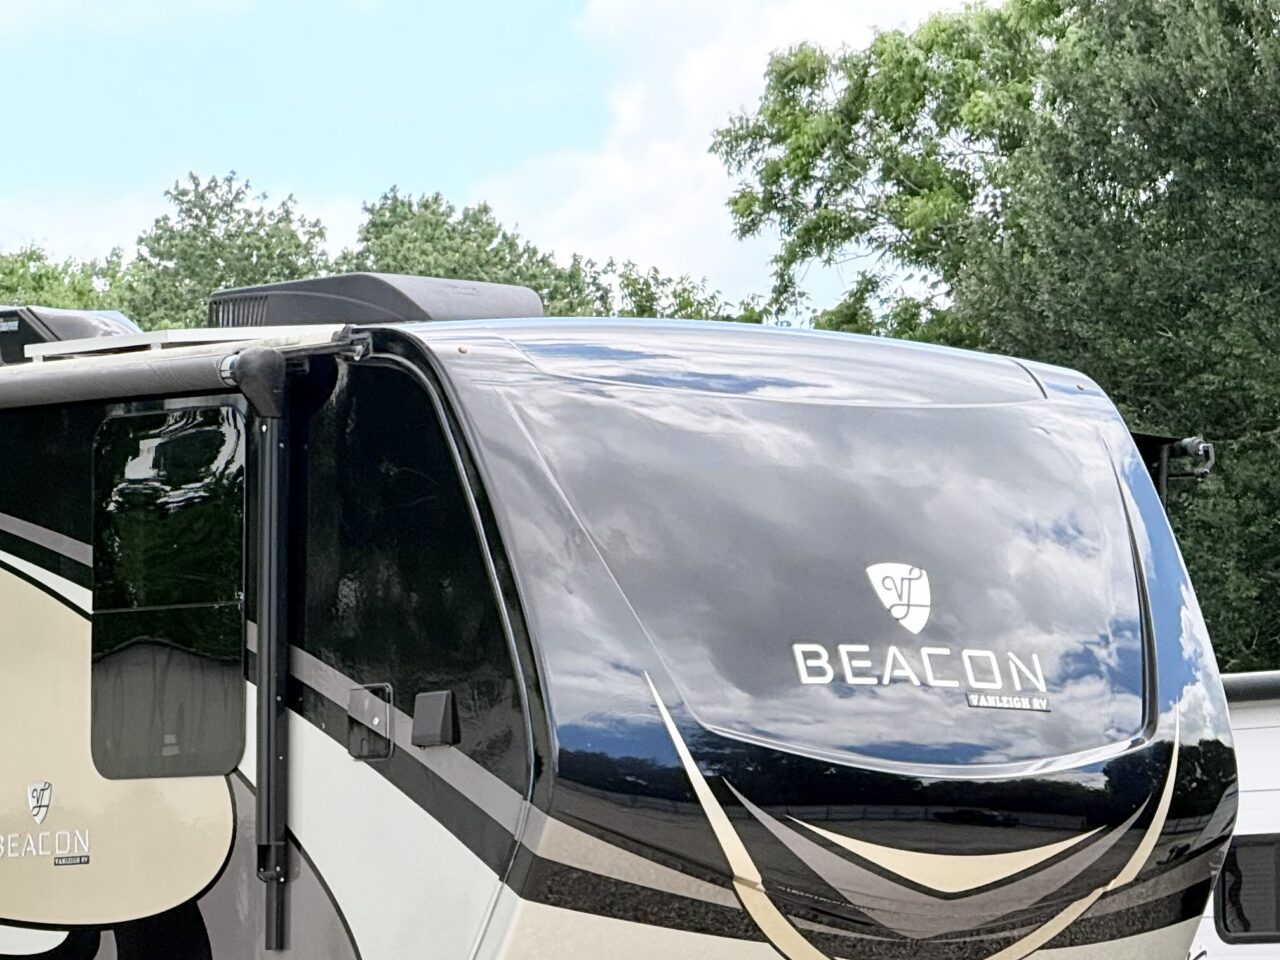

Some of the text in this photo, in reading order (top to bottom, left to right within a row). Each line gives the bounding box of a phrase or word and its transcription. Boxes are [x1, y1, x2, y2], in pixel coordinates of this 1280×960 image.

[792, 643, 1048, 693] BEACON
[969, 693, 1048, 711] VANLEIGH RV
